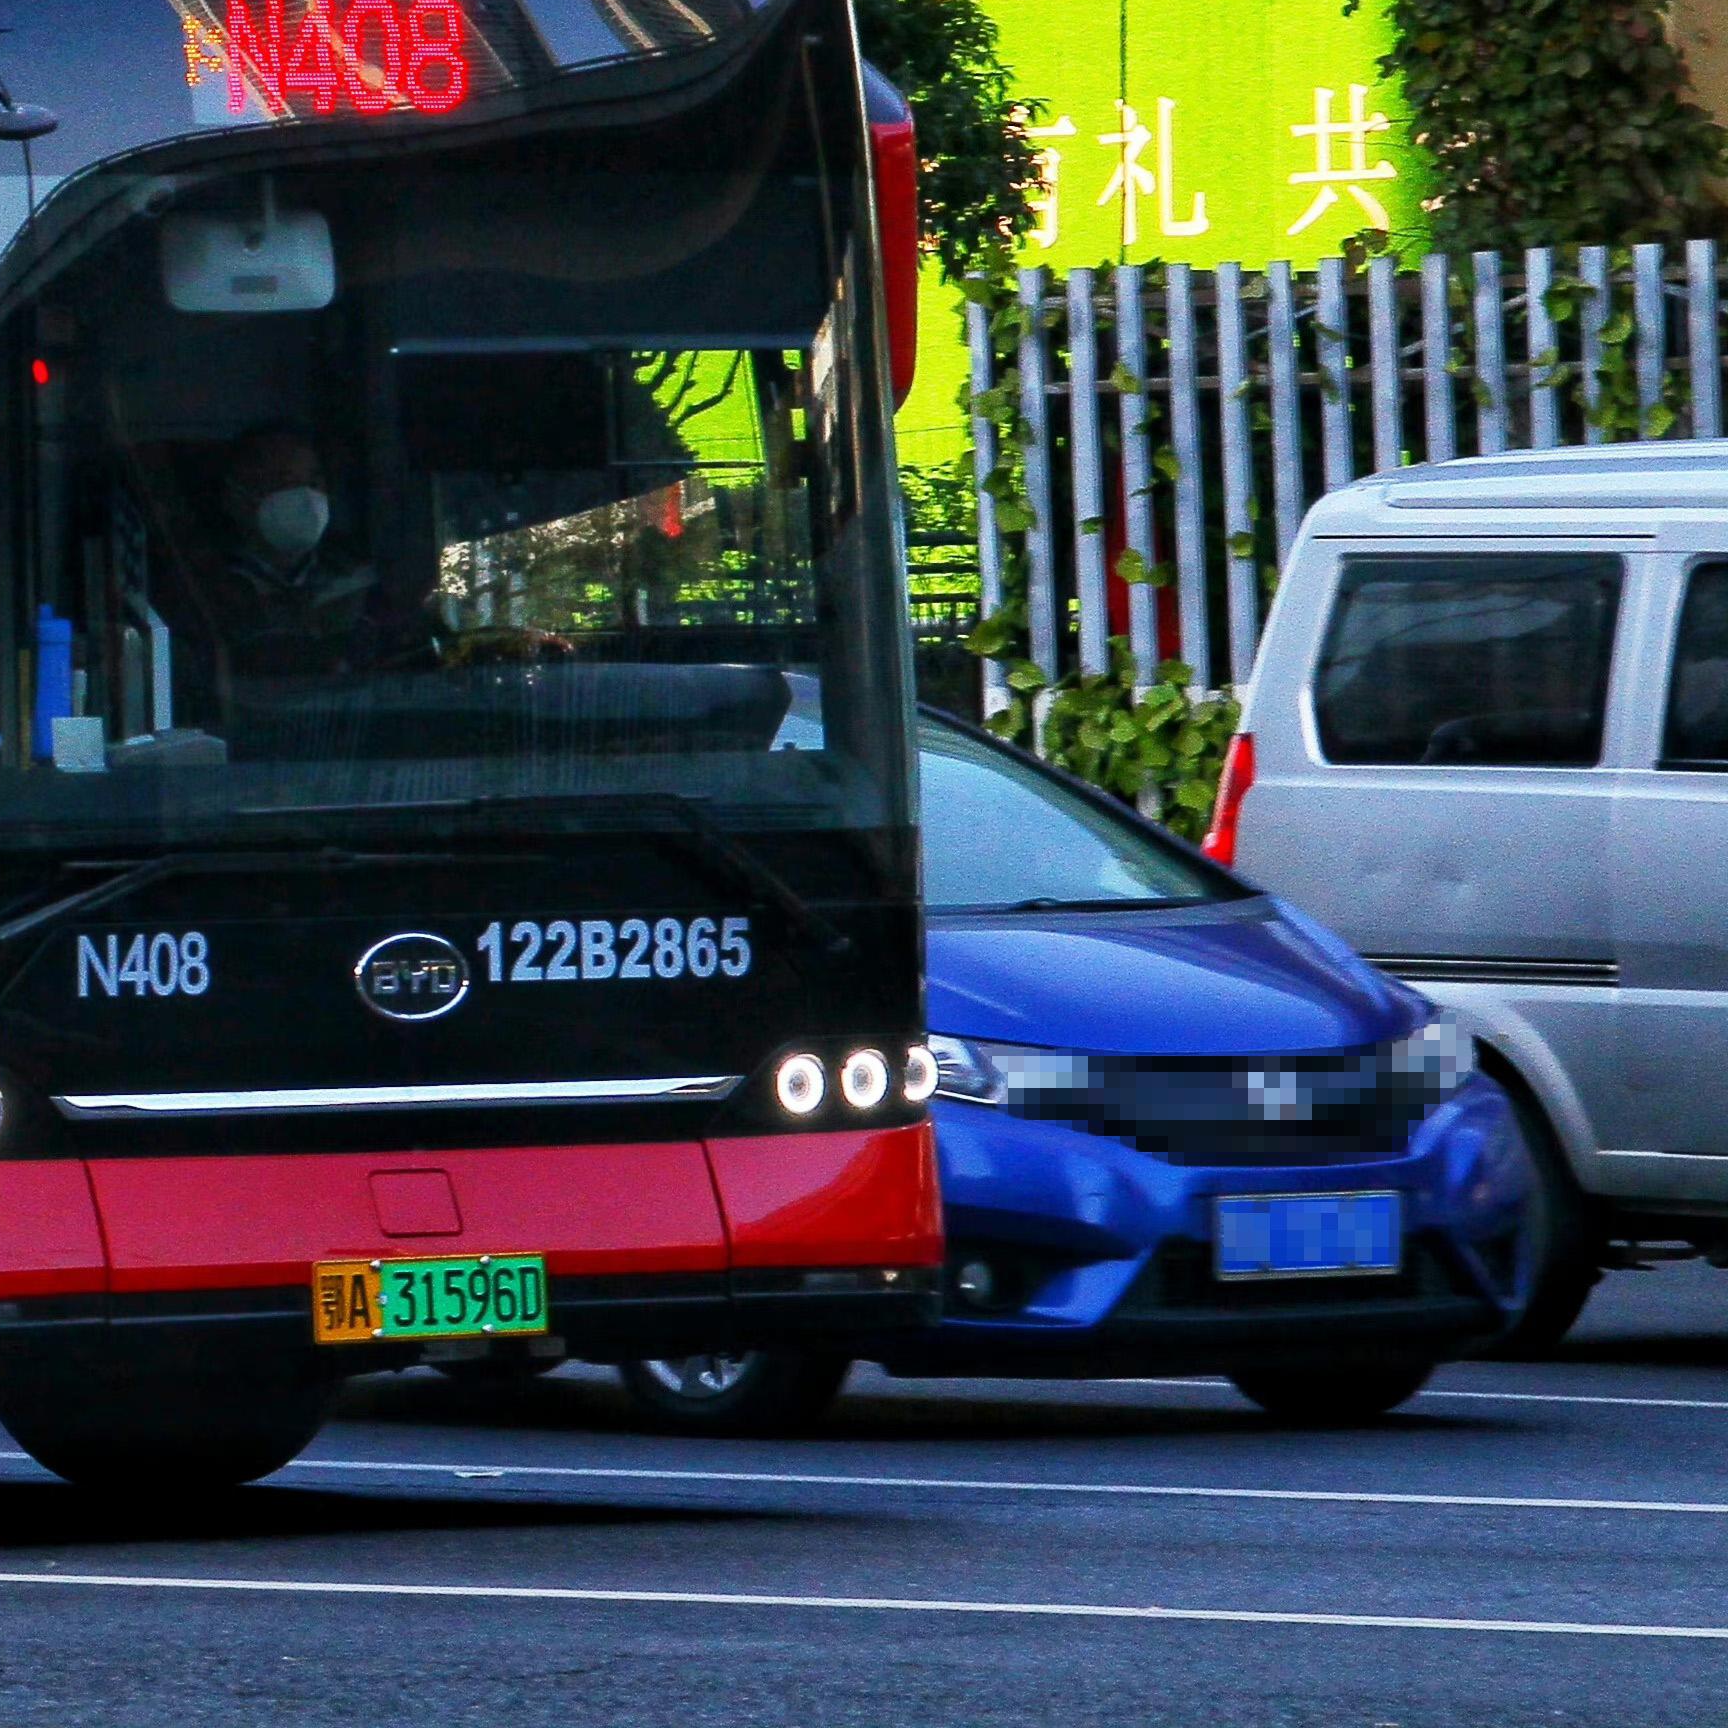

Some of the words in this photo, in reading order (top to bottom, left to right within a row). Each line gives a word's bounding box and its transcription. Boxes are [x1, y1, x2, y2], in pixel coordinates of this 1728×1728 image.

[1287, 83, 1398, 237] 共
[76, 930, 208, 997] N408
[371, 959, 458, 994] BYD
[476, 917, 752, 983] 122B2865
[393, 1266, 544, 1328] 31596D
